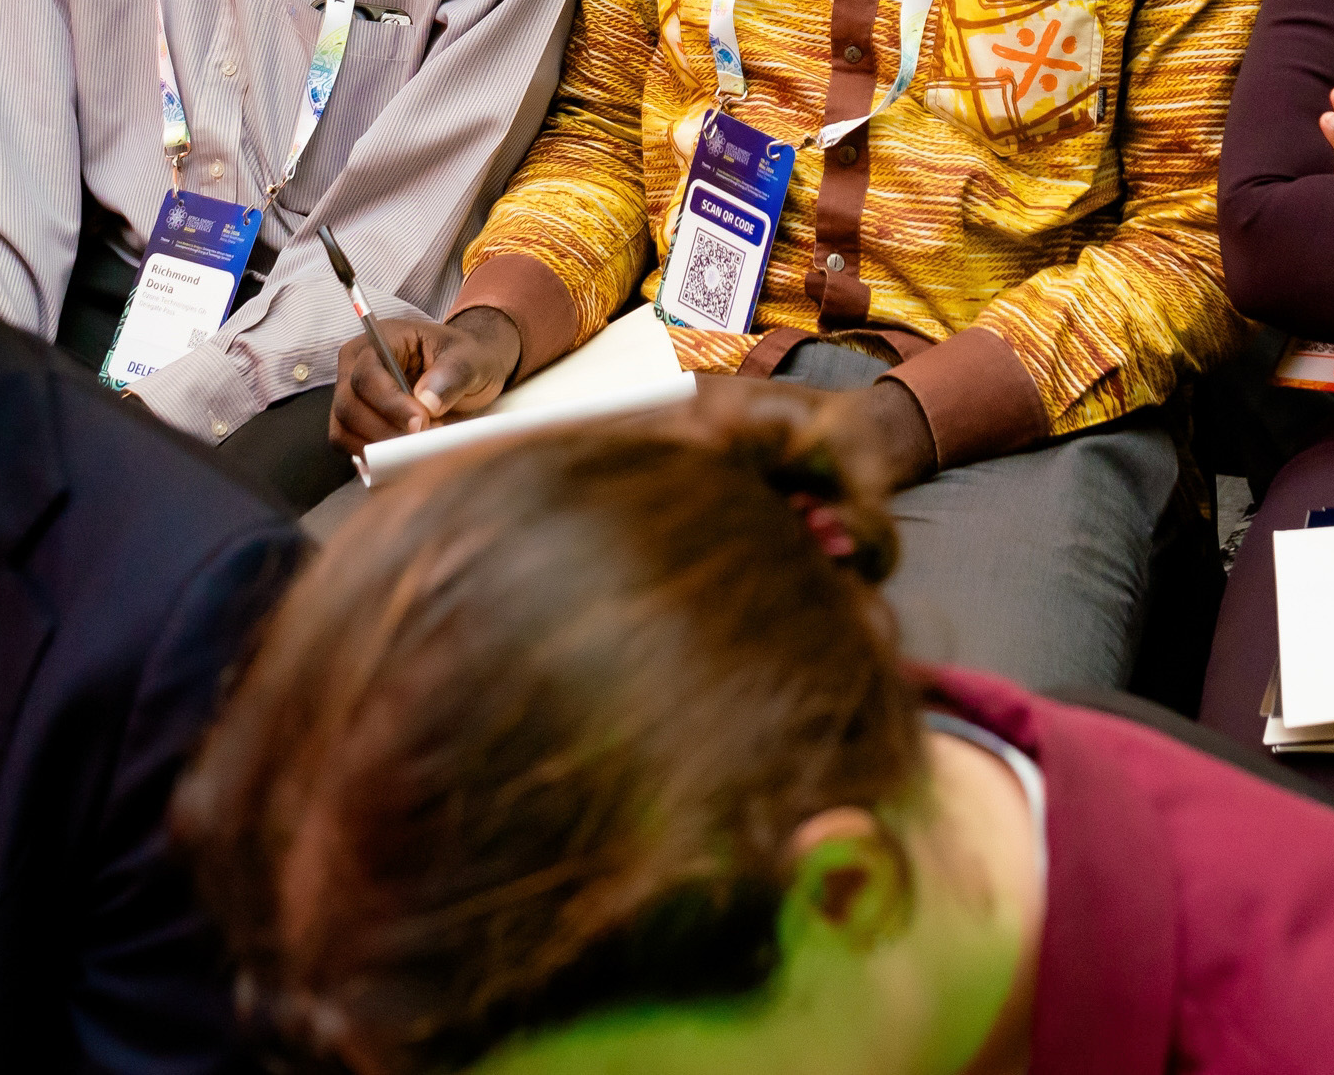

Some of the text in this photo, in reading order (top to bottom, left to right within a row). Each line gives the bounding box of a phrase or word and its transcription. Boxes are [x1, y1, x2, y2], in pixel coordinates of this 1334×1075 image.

[701, 199, 755, 235] SCAN QR CODE
[146, 278, 174, 294] Dovia
[151, 264, 201, 286] Richmond
